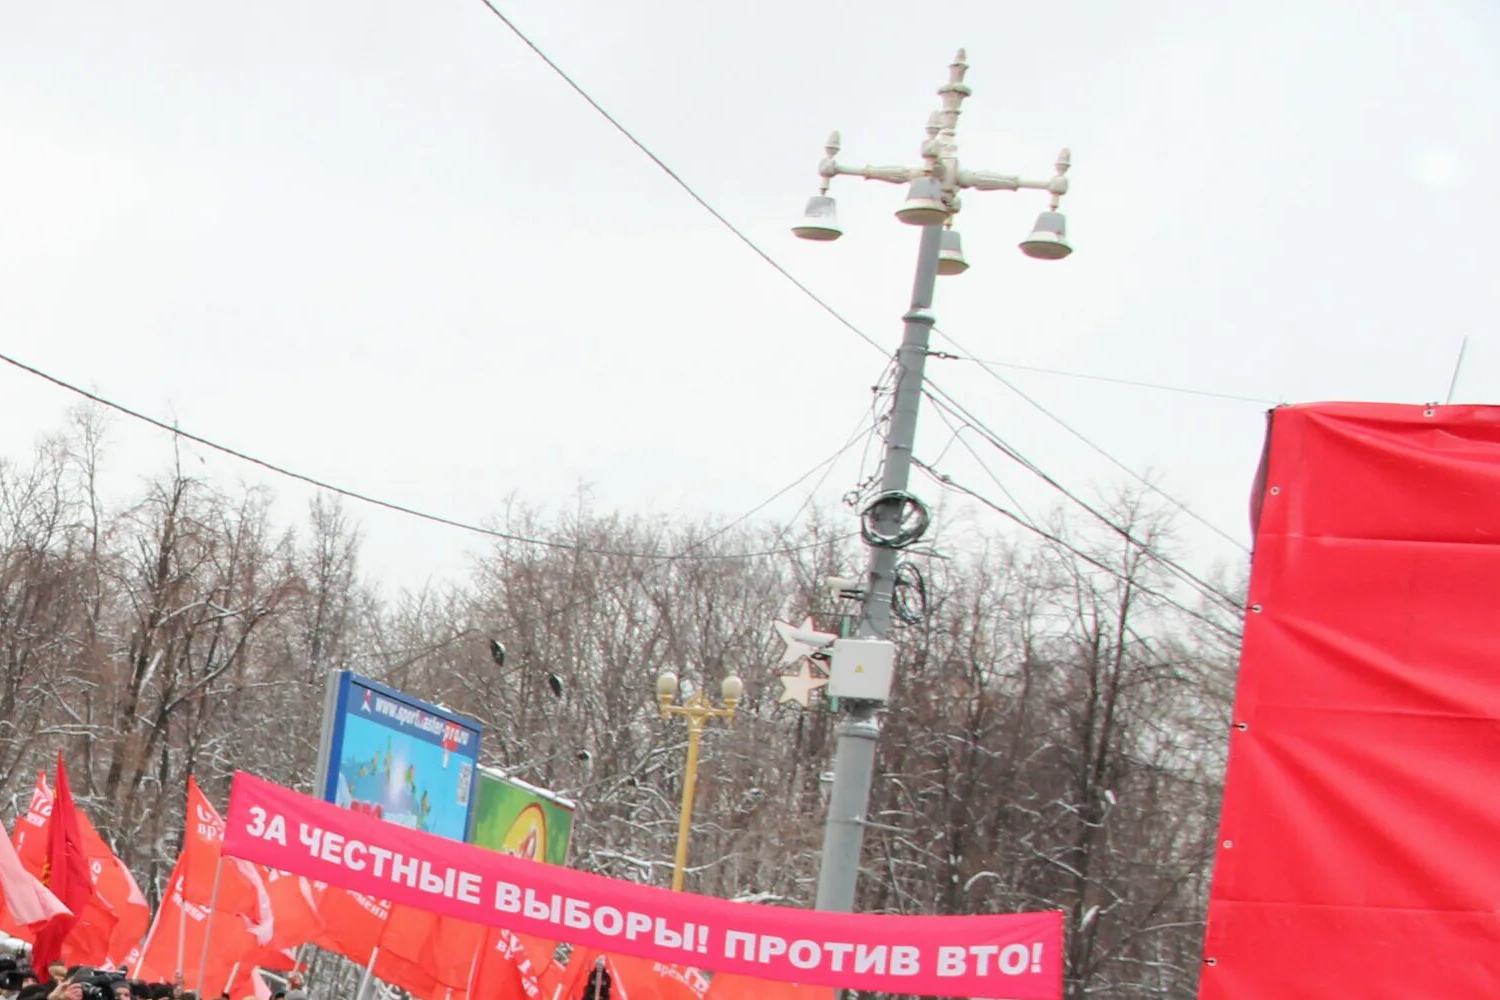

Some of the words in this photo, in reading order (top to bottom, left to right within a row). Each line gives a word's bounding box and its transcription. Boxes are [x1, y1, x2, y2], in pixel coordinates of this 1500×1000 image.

[245, 807, 288, 847] ЗА
[299, 826, 483, 905] ЧЕСТНЫЕ
[494, 880, 709, 954] ВЫБОРЫ!
[723, 929, 921, 977] ПРОТИВ
[936, 942, 1044, 977] ВТО!
